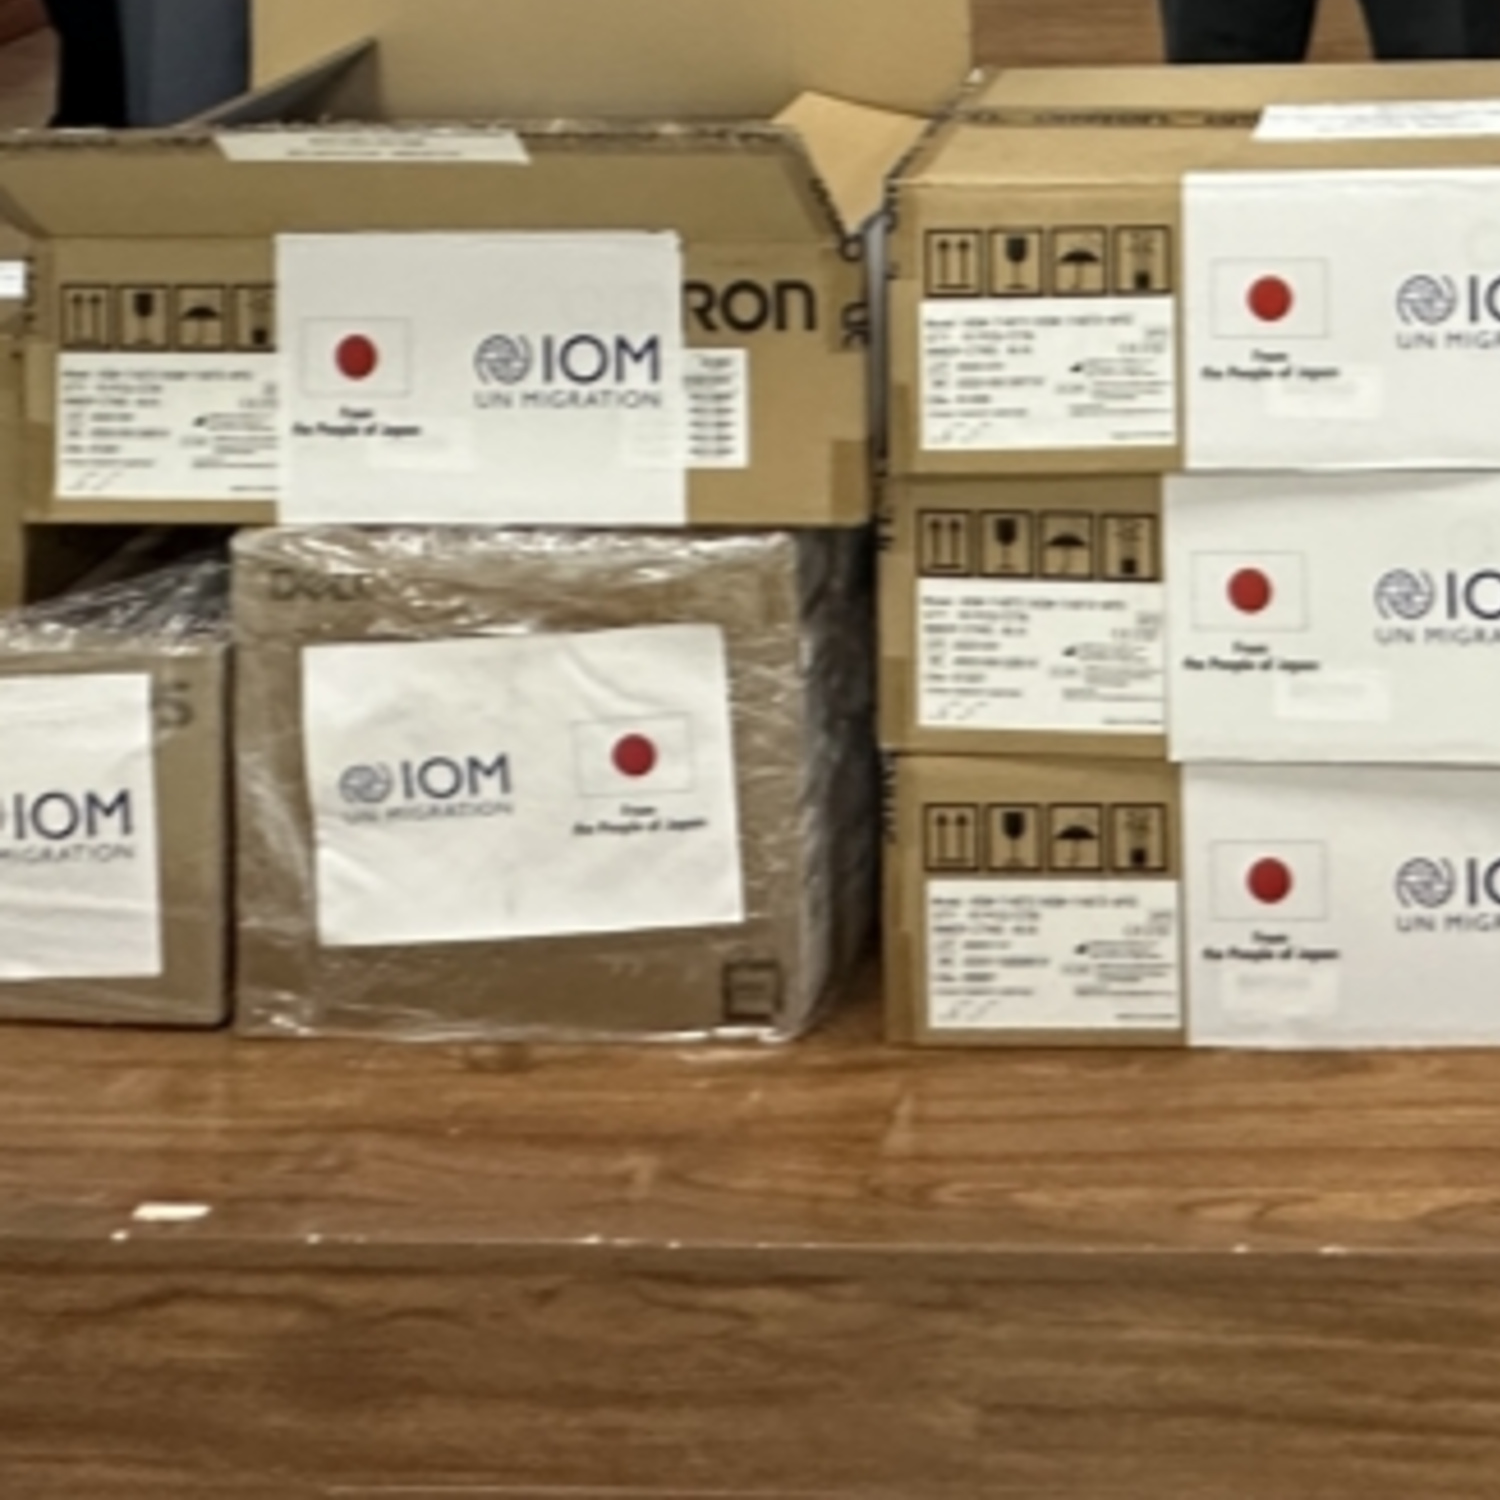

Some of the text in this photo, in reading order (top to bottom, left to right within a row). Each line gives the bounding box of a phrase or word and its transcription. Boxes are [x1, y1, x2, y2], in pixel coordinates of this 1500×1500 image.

[1396, 332, 1435, 349] UN
[542, 334, 661, 384] IOM
[473, 391, 661, 409] UN MIGRATION
[1373, 628, 1415, 646] UN
[401, 753, 511, 801] IOM
[13, 788, 133, 840] IOM
[1395, 913, 1435, 932] UN
